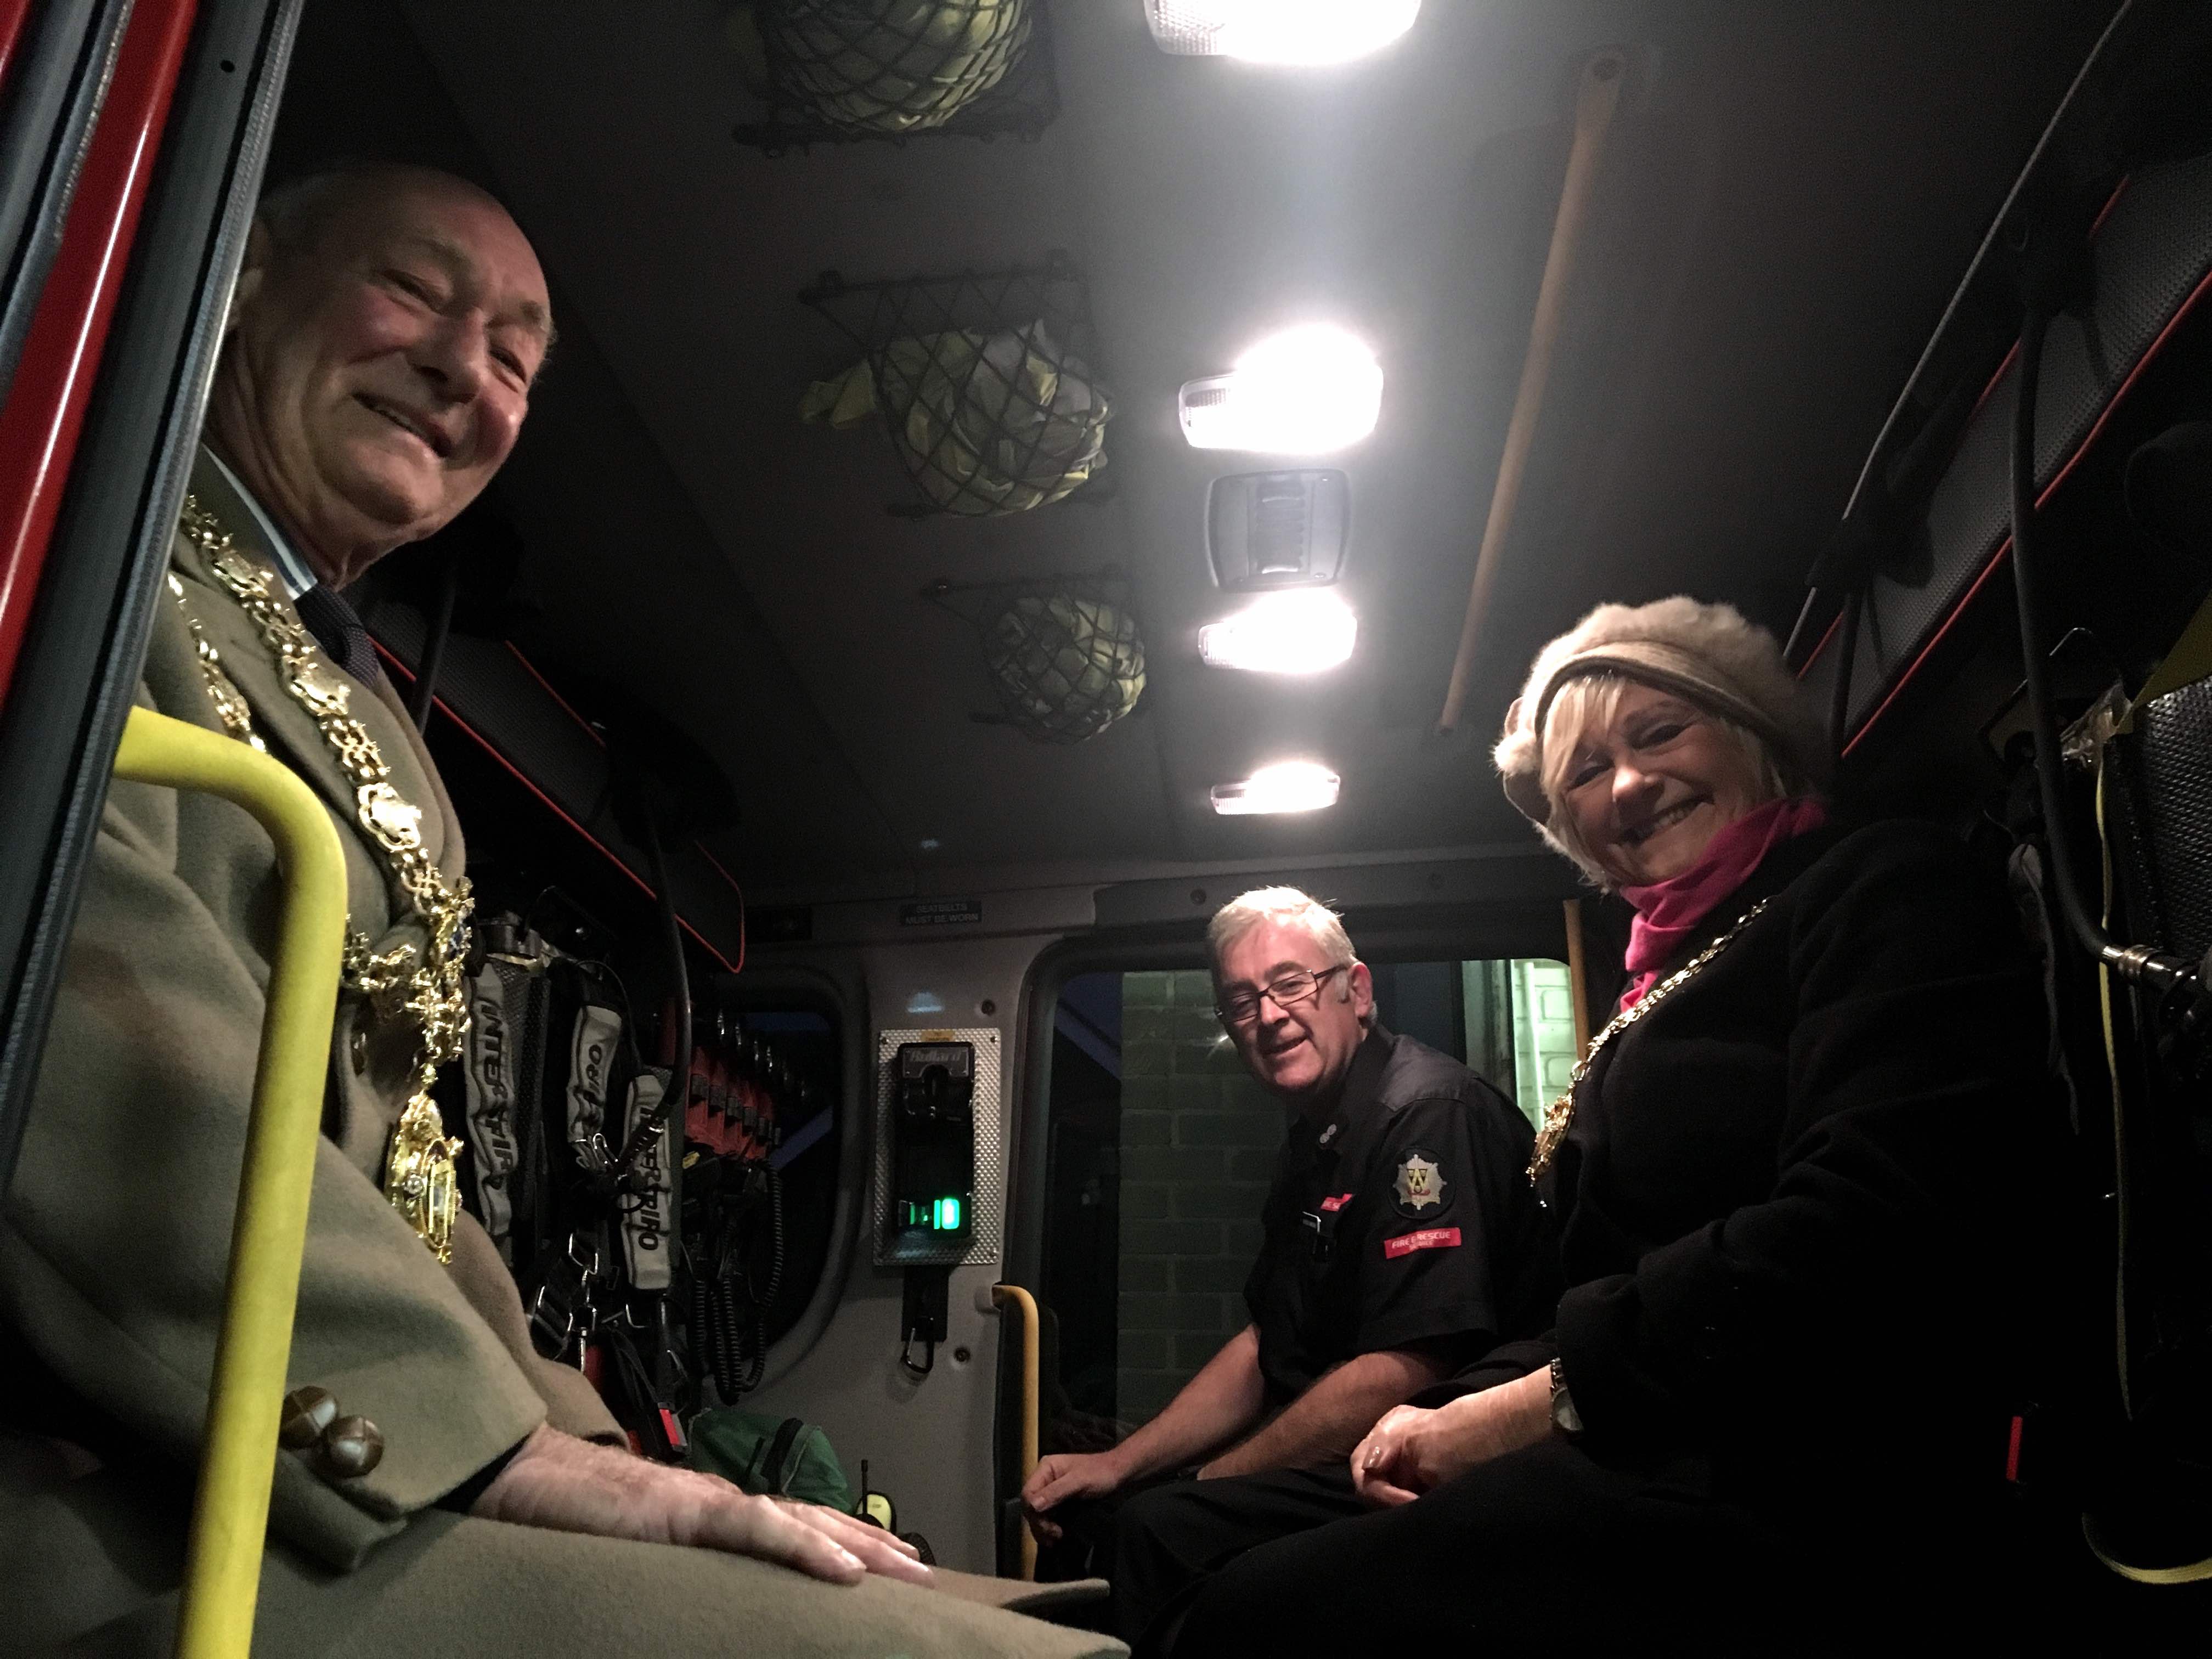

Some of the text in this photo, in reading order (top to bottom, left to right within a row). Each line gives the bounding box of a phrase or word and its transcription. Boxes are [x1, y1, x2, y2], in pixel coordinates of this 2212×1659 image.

[916, 903, 968, 913] SEATBELTS
[906, 912, 979, 924] MUST BE WORN
[1392, 1238, 1410, 1249] FIRE
[1417, 1231, 1451, 1241] RESCUE
